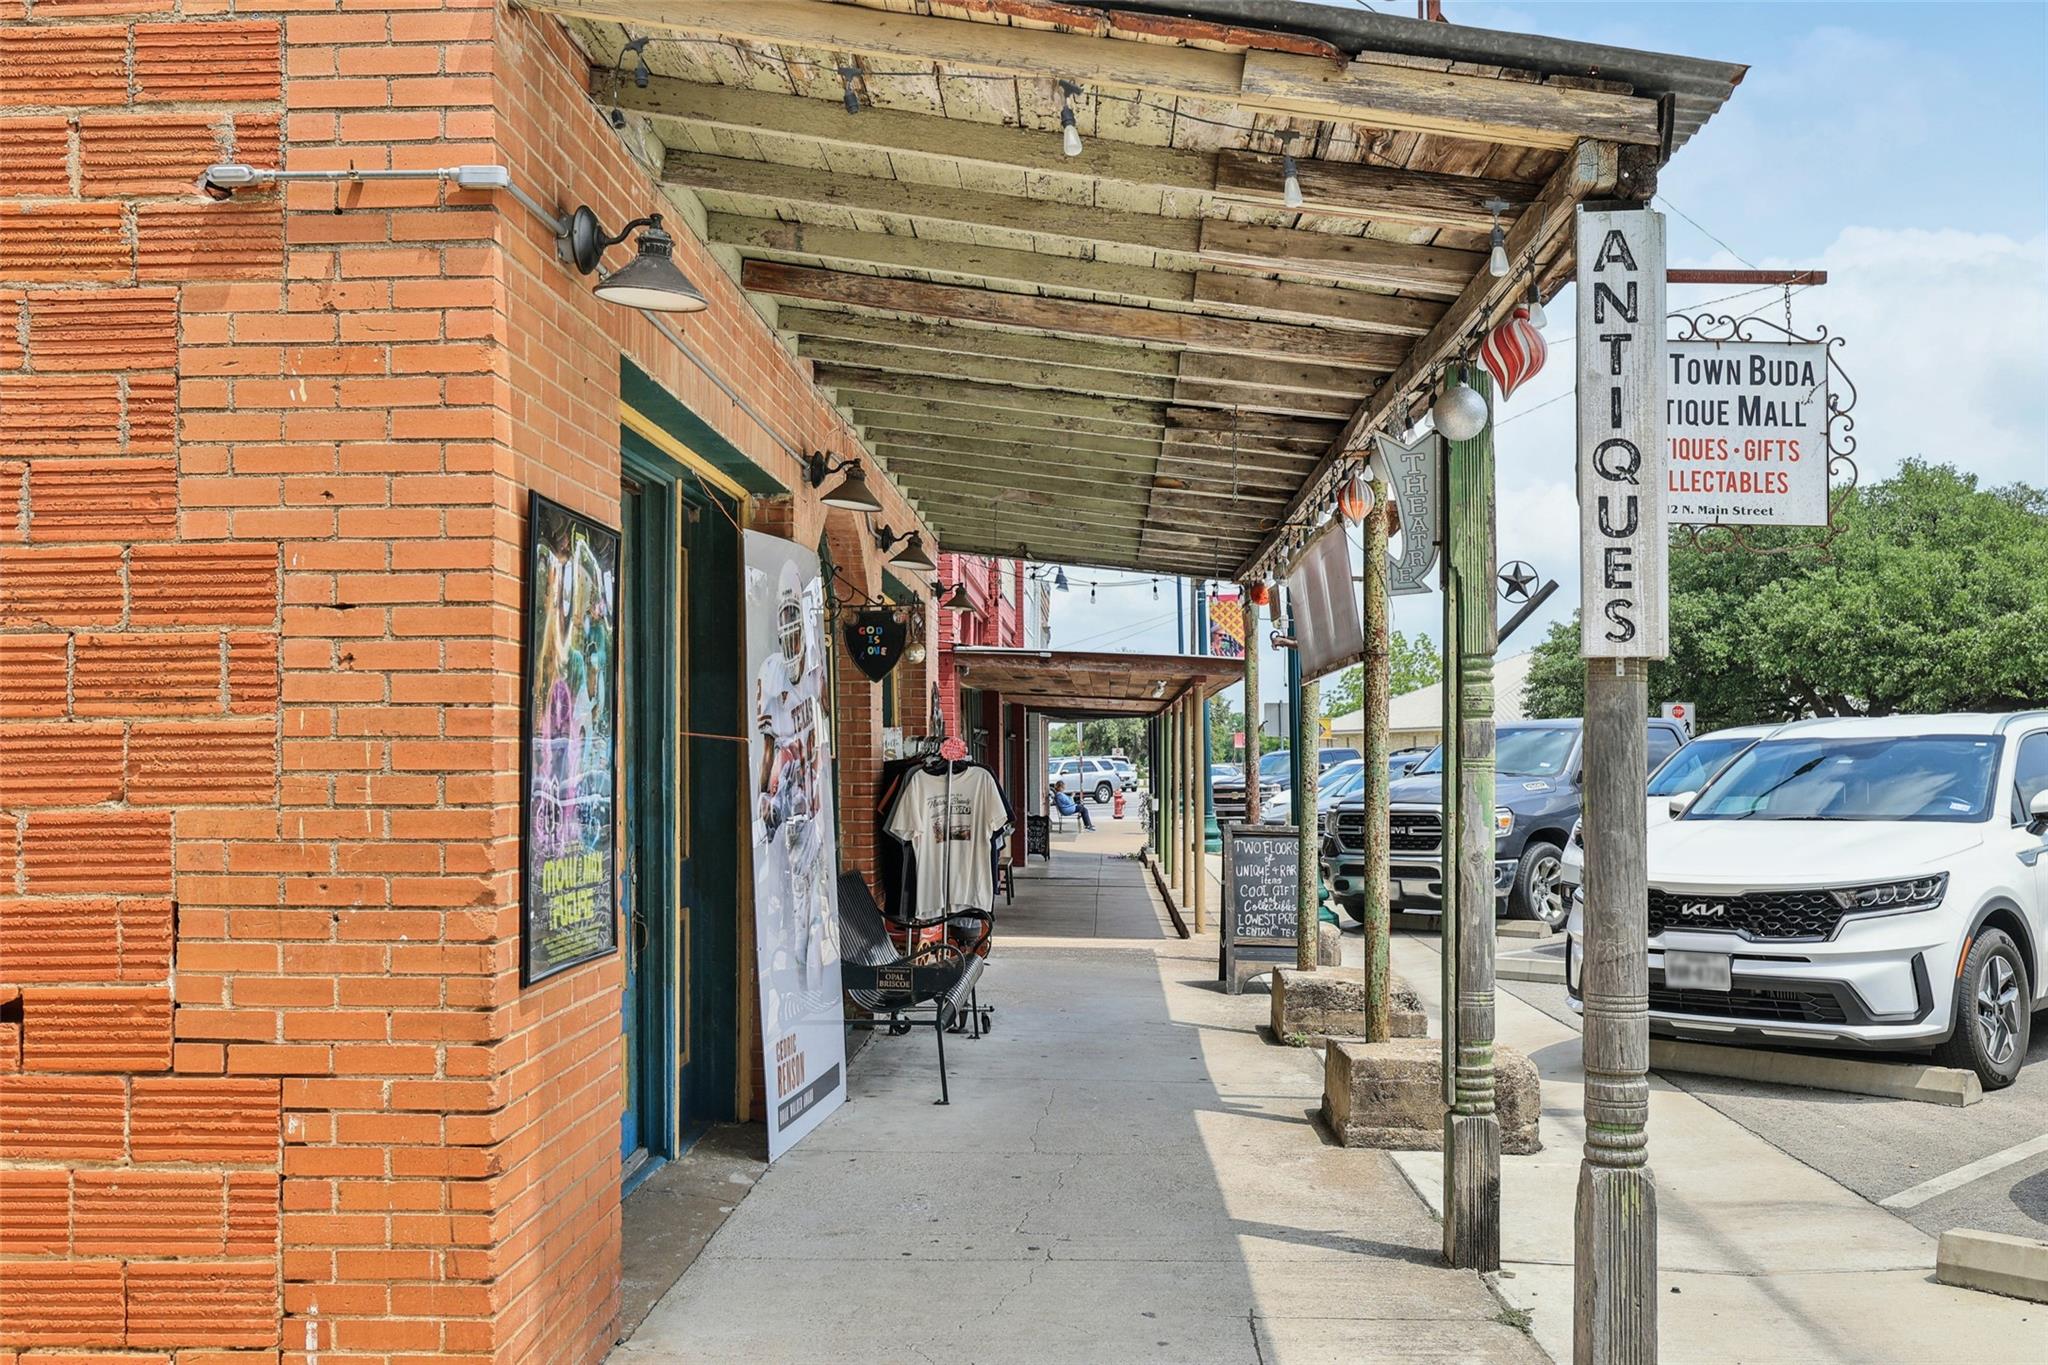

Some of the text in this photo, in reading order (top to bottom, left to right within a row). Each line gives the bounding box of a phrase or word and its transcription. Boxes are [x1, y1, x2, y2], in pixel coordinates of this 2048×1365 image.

[1669, 353, 1815, 387] TOWN BUDA
[1738, 395, 1807, 427] MALL
[1593, 230, 1641, 643] ANTIQUES
[1667, 437, 1800, 462] IQUES GIFTS
[1669, 470, 1789, 494] LLECTABLES
[1682, 505, 1694, 514] N.
[1697, 505, 1729, 515] Main
[1732, 506, 1774, 516] Street
[1398, 453, 1429, 583] THEATRE
[858, 625, 883, 636] GOD
[867, 635, 880, 645] IS
[1233, 840, 1299, 856] TWO FLOORS
[1235, 864, 1270, 877] UNIQUE
[1272, 885, 1297, 896] GIFT
[1681, 903, 1725, 917] KIA
[1238, 912, 1277, 926] LOWEST
[1236, 926, 1276, 936] CENTRAL
[885, 973, 905, 981] OPAL
